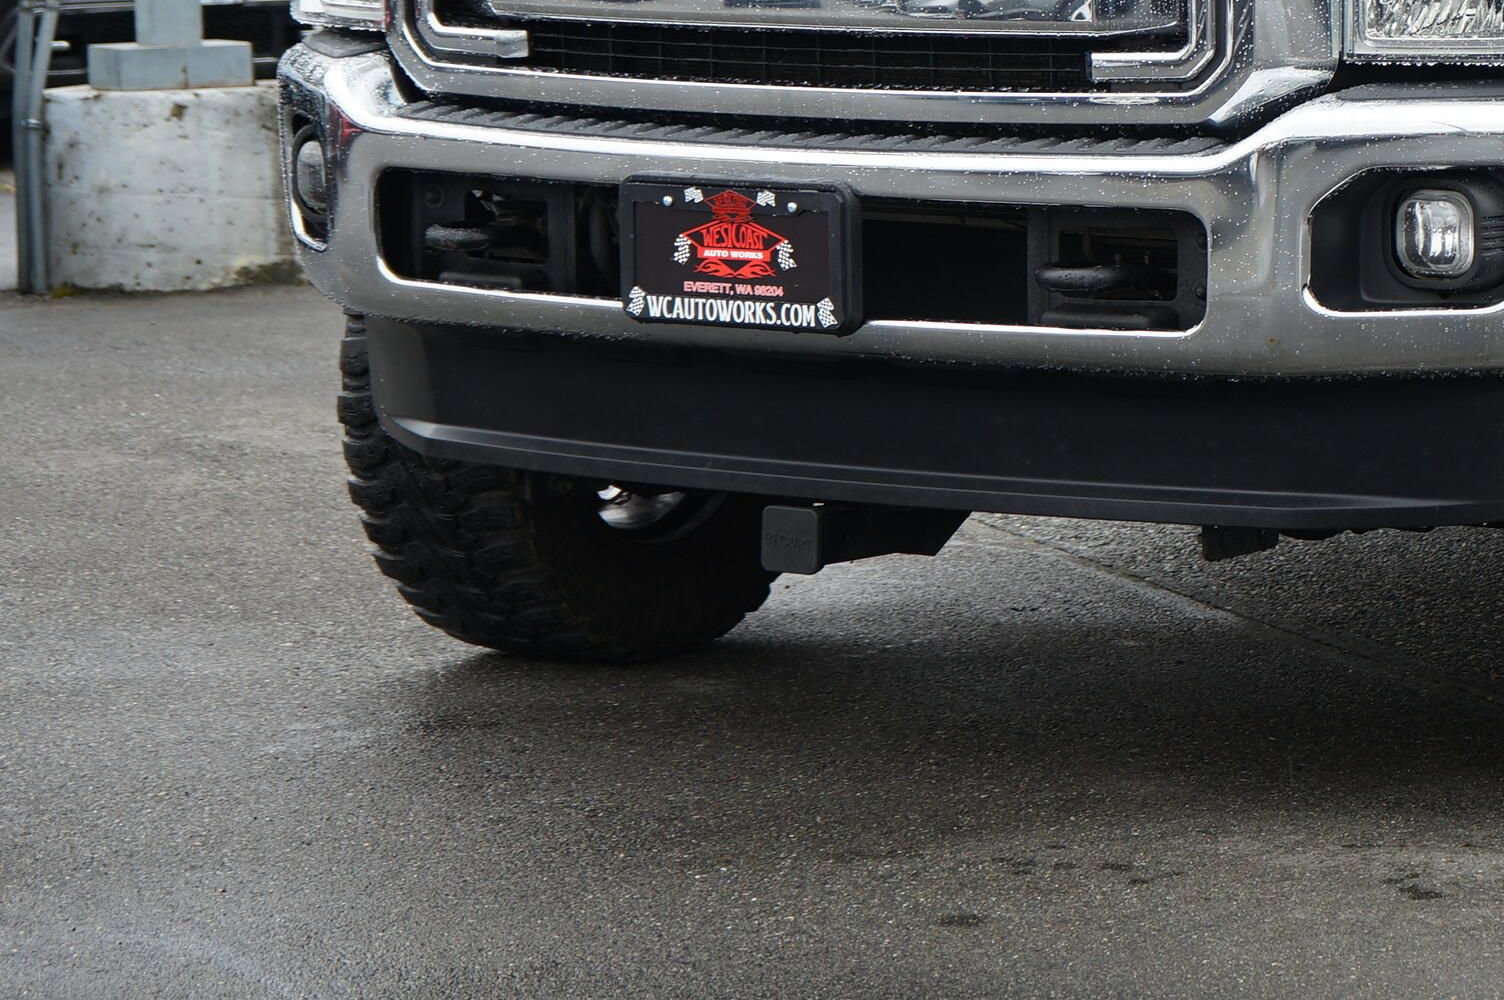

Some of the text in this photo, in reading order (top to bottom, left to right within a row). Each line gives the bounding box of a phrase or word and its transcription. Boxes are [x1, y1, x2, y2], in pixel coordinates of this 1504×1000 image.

[701, 223, 733, 248] WEST
[703, 249, 764, 260] AUTO WORKS
[683, 280, 734, 296] EVERETT,
[735, 283, 753, 296] WA
[647, 295, 816, 327] WCAUTOWORKS.COM
